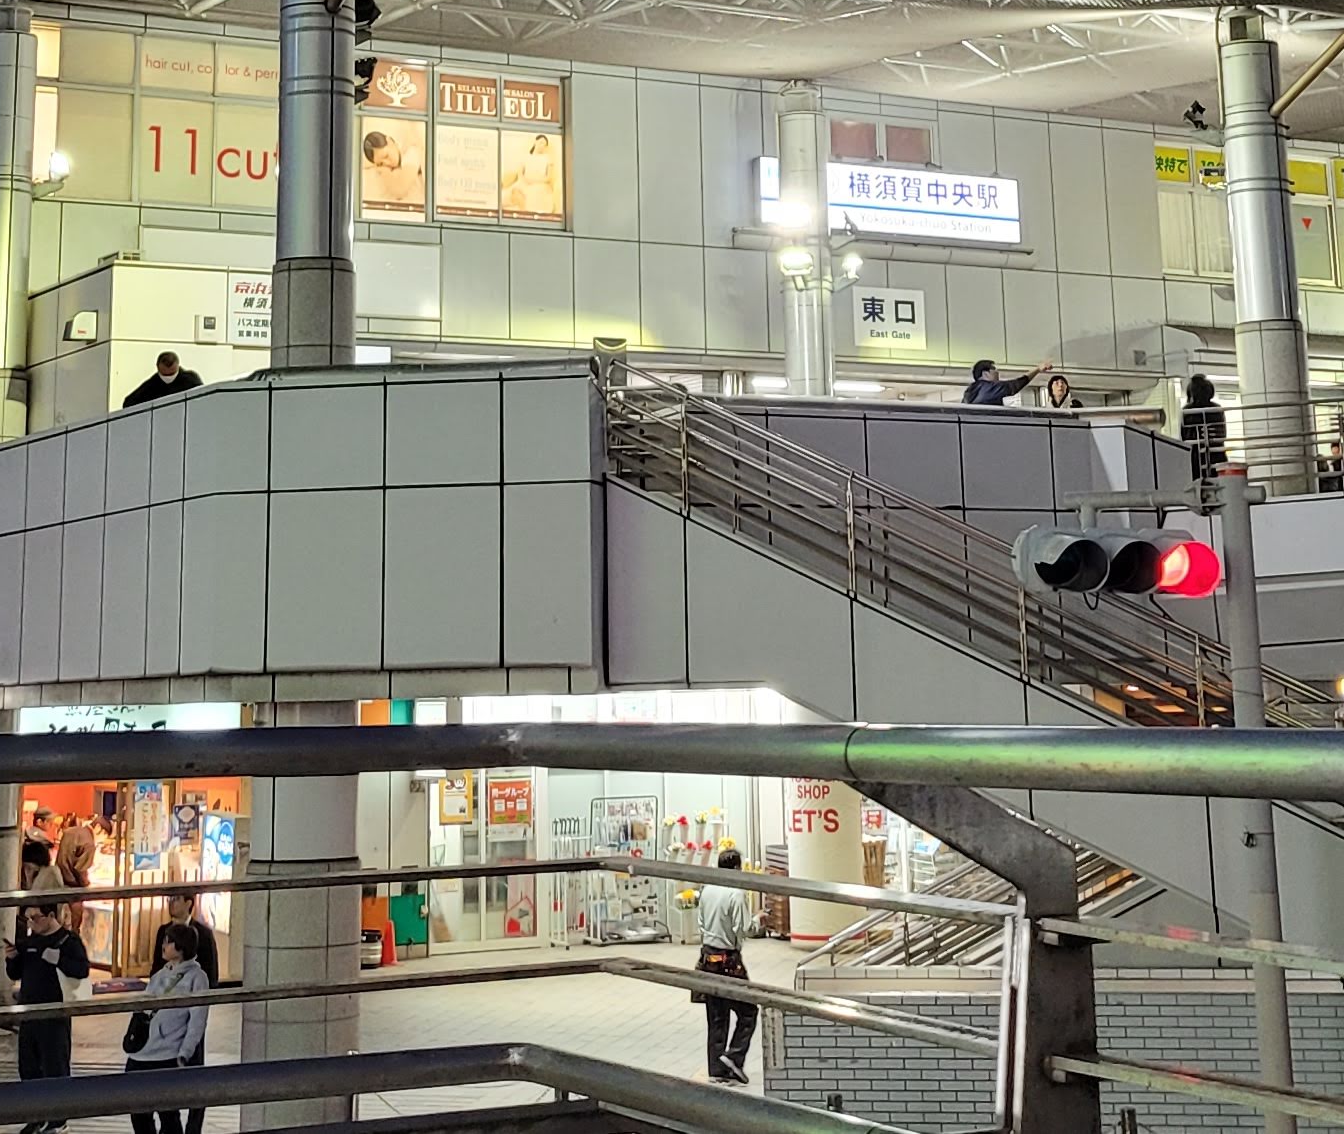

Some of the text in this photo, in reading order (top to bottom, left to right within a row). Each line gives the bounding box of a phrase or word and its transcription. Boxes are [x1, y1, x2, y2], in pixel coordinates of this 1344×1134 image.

[145, 54, 168, 69] hair
[243, 66, 252, 77] &
[440, 82, 552, 120] TILLEUL
[848, 170, 999, 210] 横須賀中央駅
[951, 219, 992, 234] Station
[861, 296, 916, 325] 東口
[870, 329, 911, 340] East Gate
[797, 785, 831, 800] SHOP
[789, 808, 840, 833] ET'S
